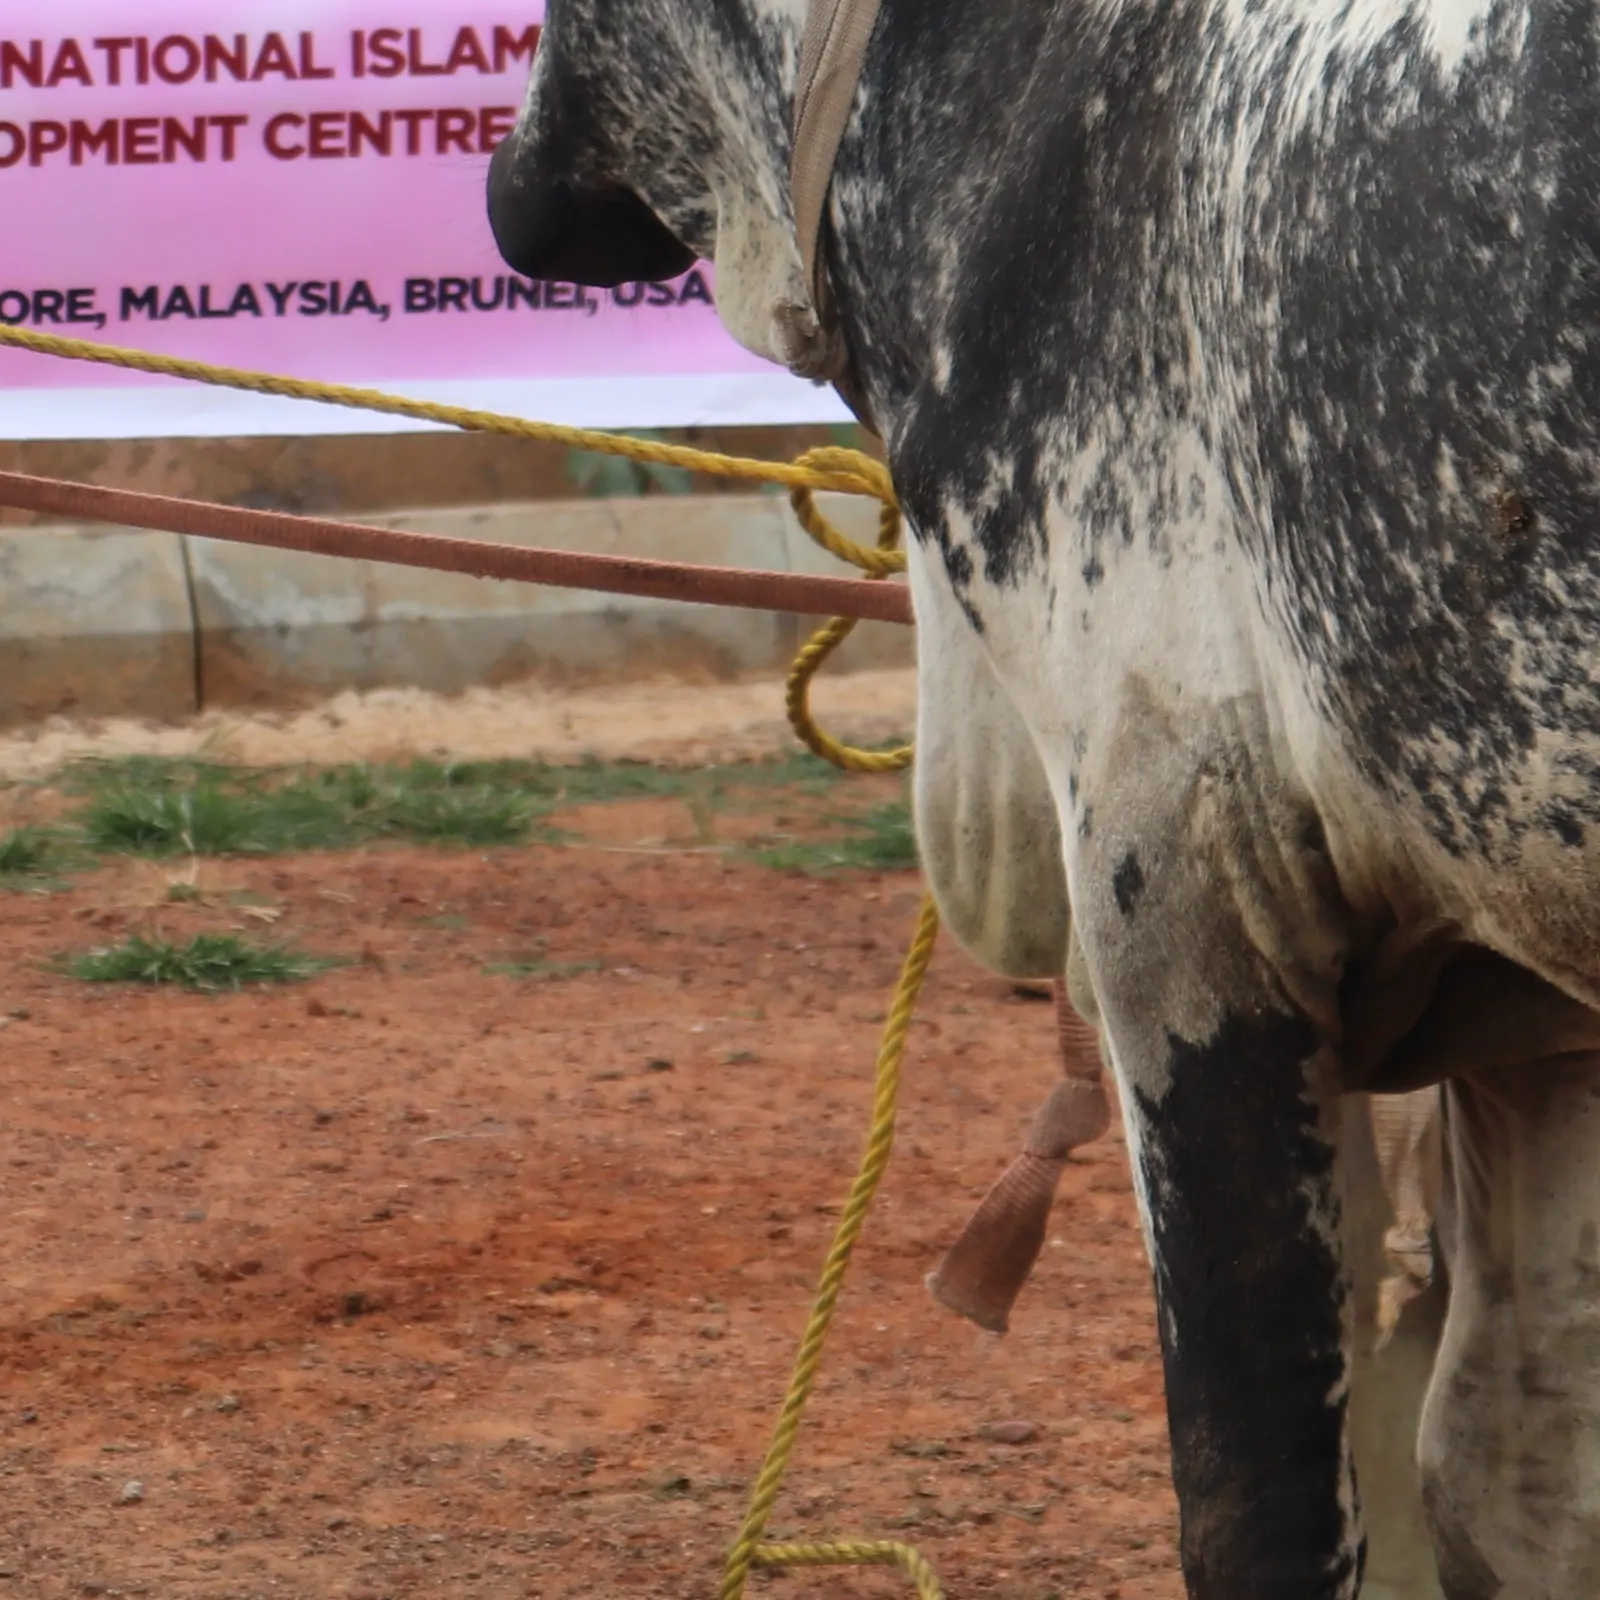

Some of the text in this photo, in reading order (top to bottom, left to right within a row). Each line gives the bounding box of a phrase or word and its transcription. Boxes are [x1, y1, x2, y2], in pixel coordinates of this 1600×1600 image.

[351, 23, 544, 81] ISLAM
[263, 106, 517, 161] CENTRE
[120, 278, 391, 323] MALAYSIA,
